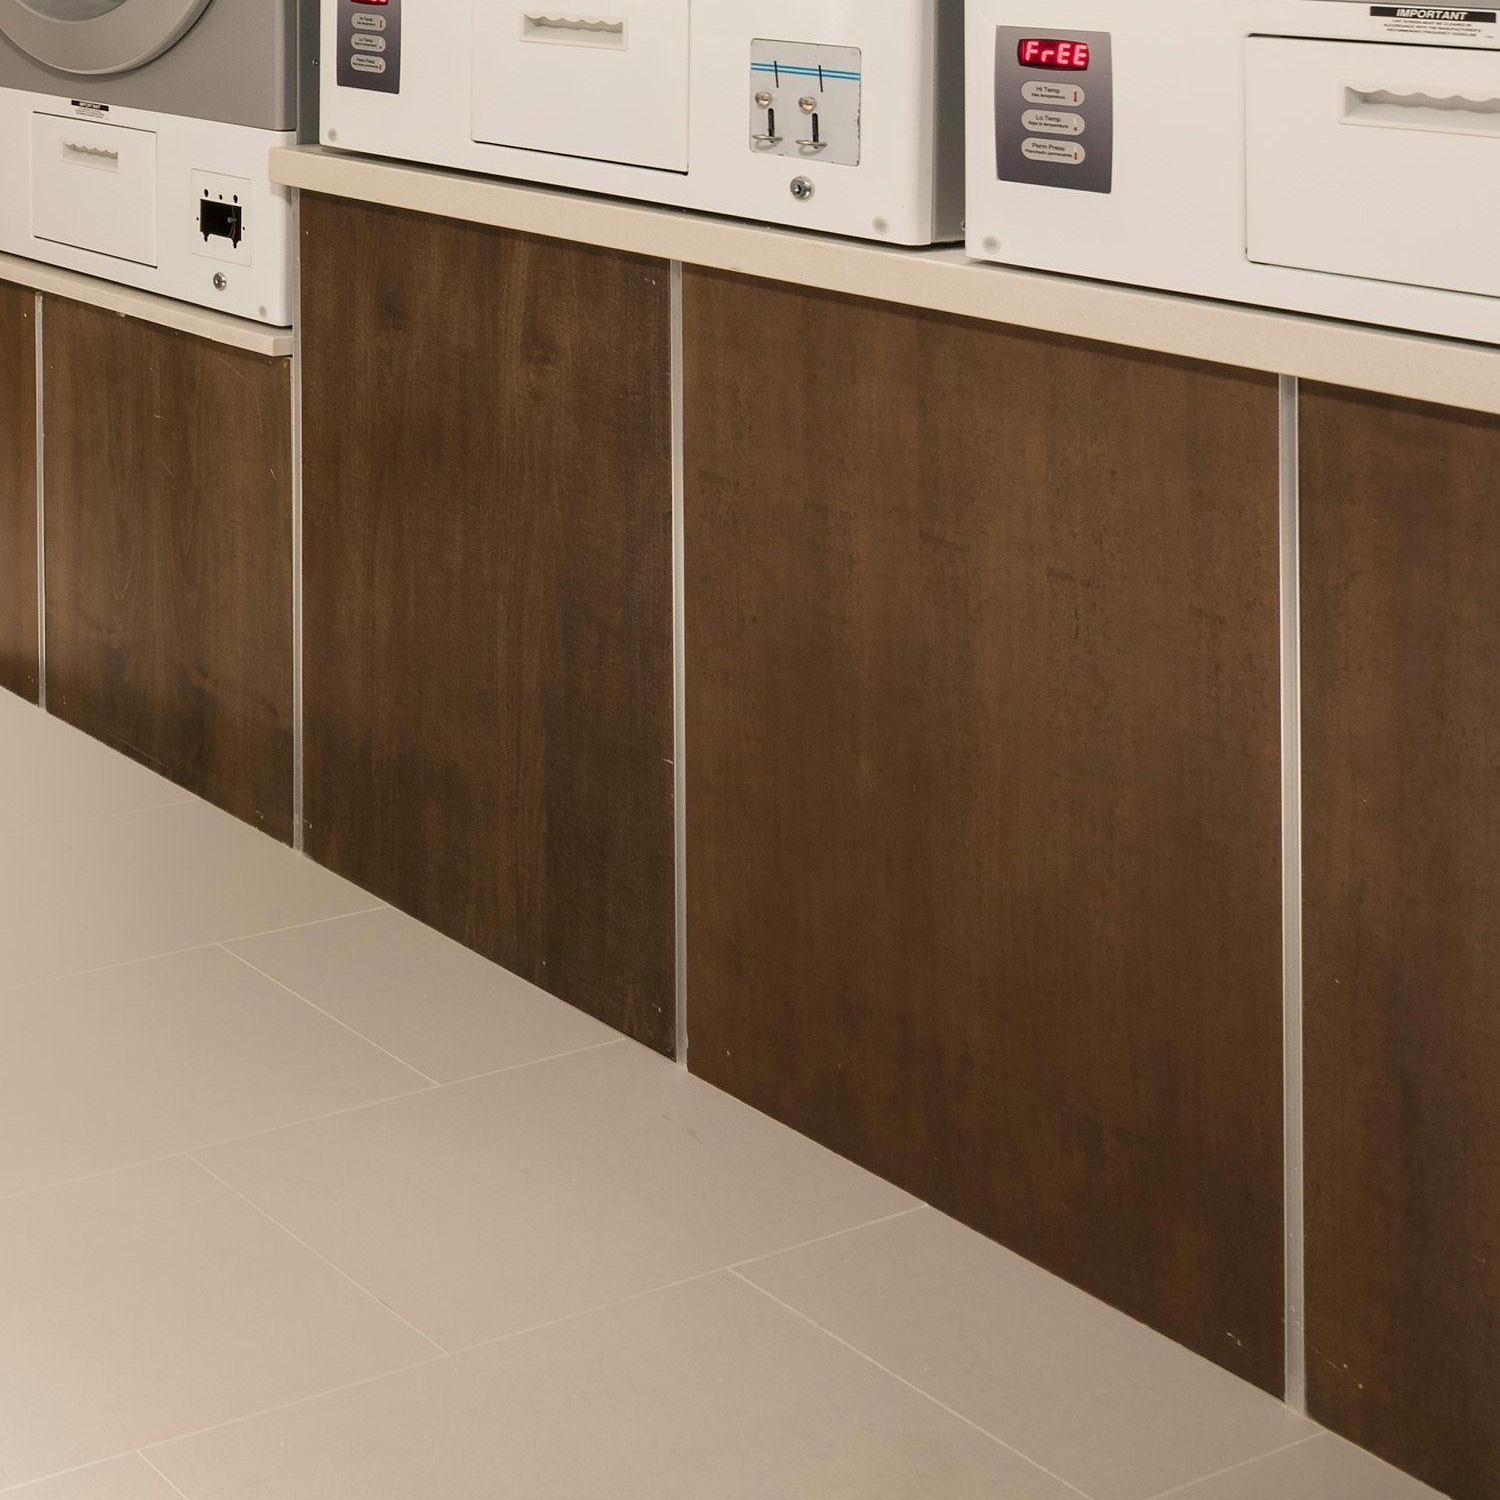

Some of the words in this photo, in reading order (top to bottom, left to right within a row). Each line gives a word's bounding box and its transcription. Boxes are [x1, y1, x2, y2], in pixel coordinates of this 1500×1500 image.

[1396, 8, 1469, 20] IMPORTANT
[1043, 86, 1060, 94] Temp
[1044, 115, 1062, 123] Temp
